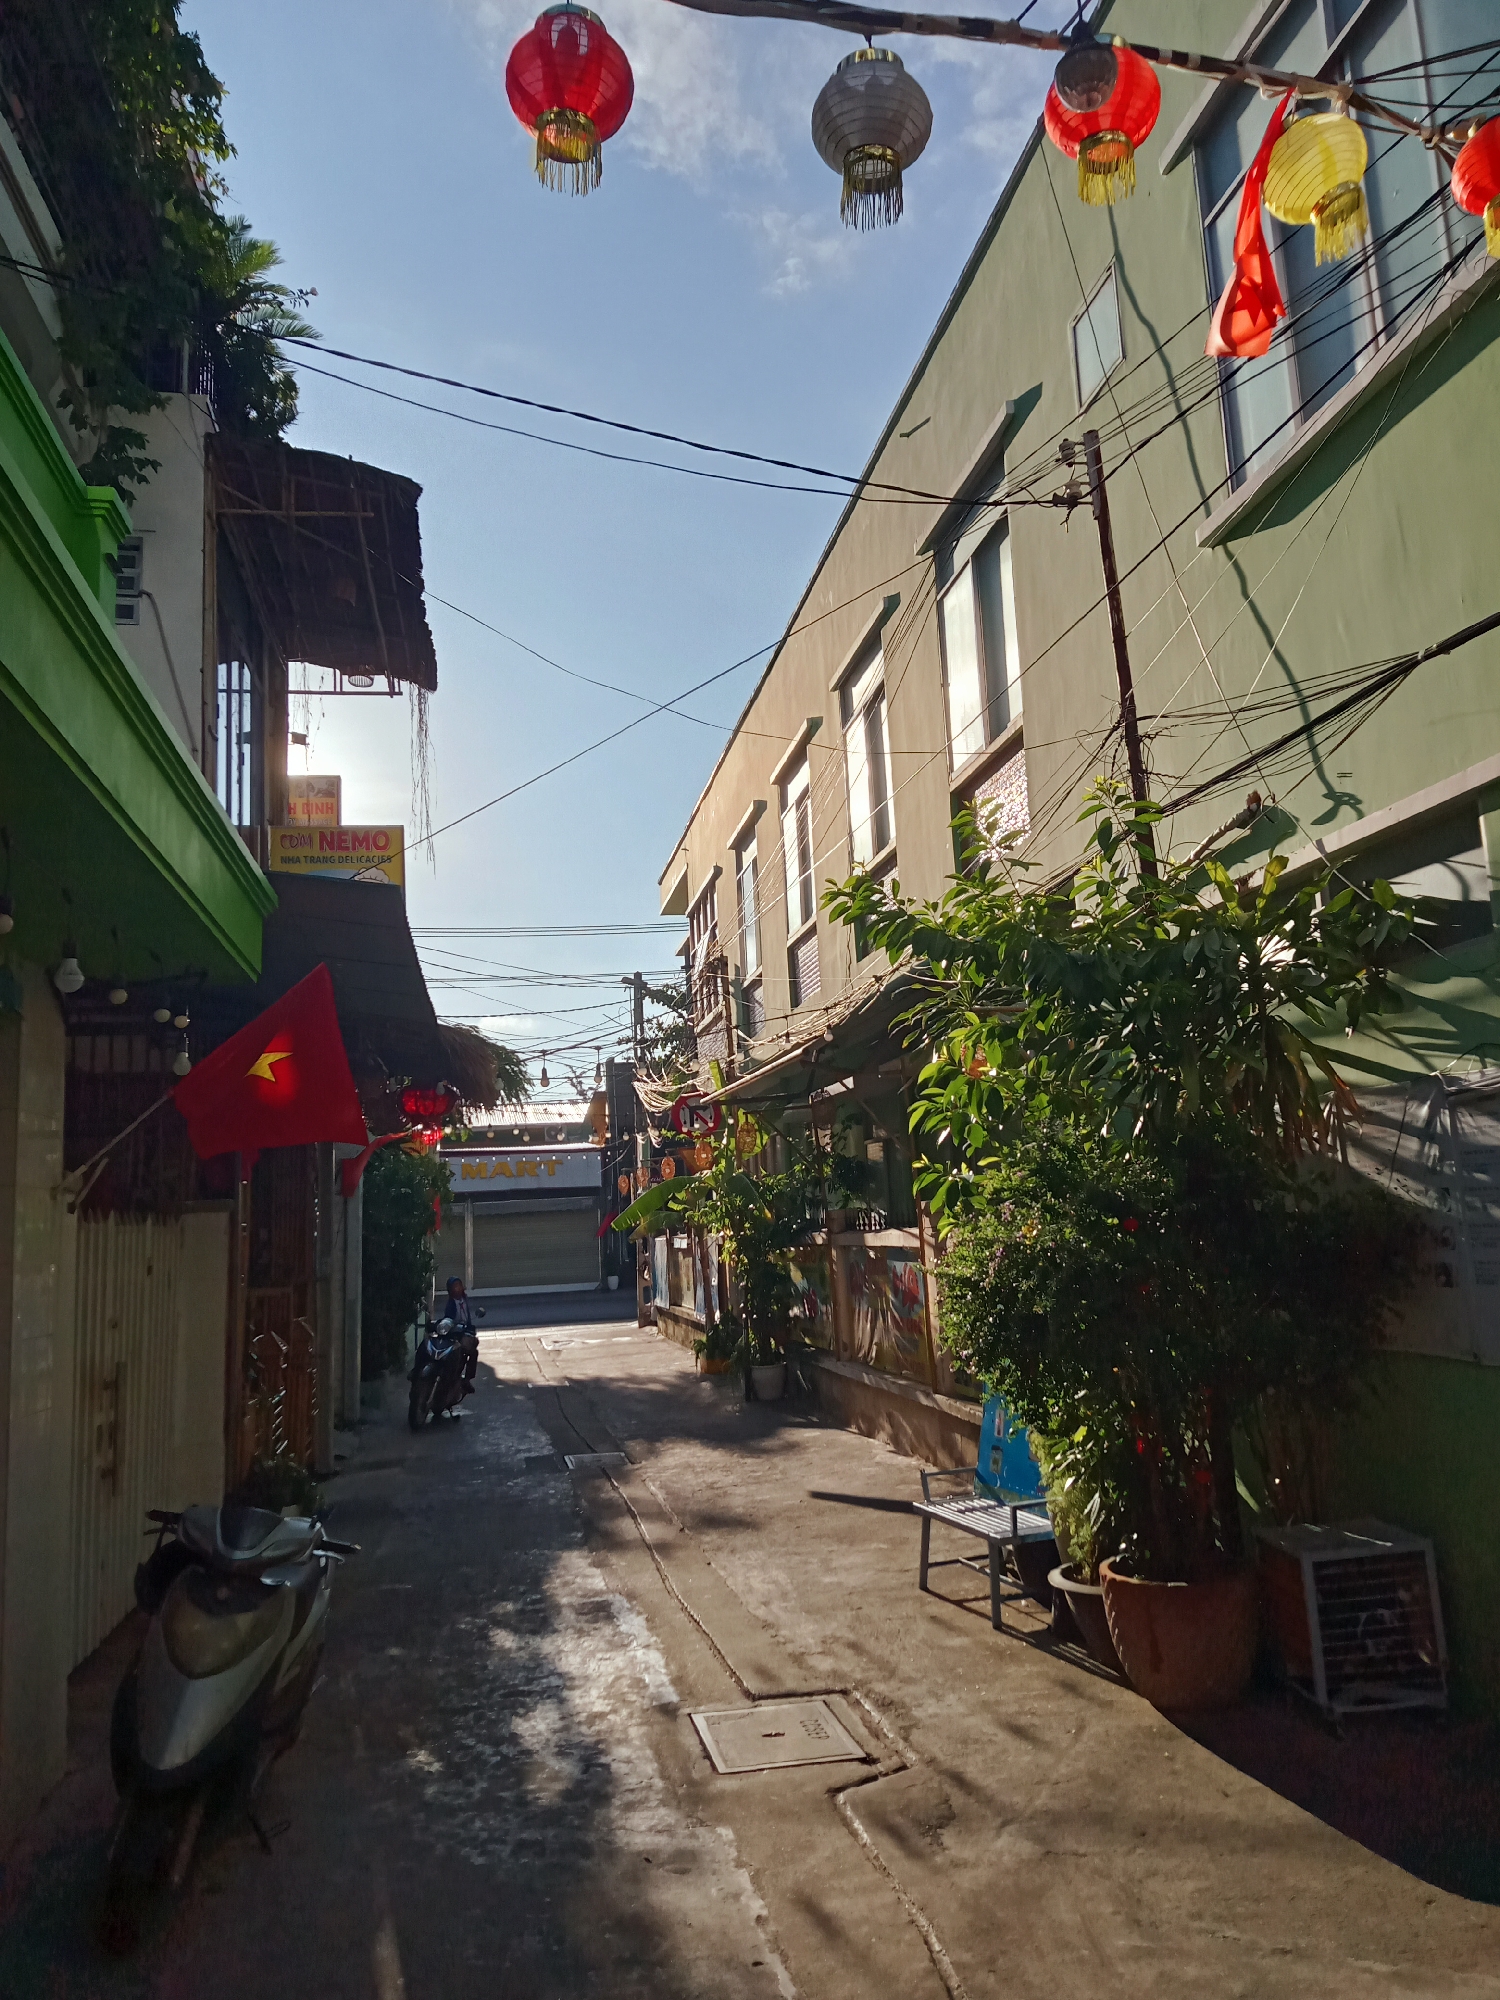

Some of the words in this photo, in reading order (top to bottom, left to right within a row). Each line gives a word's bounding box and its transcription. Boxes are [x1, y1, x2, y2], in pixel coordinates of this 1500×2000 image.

[318, 830, 391, 852] NEMO
[280, 856, 301, 864] NHA
[303, 856, 336, 864] TRANG
[338, 855, 392, 864] DELICACIES
[461, 1159, 564, 1180] MART
